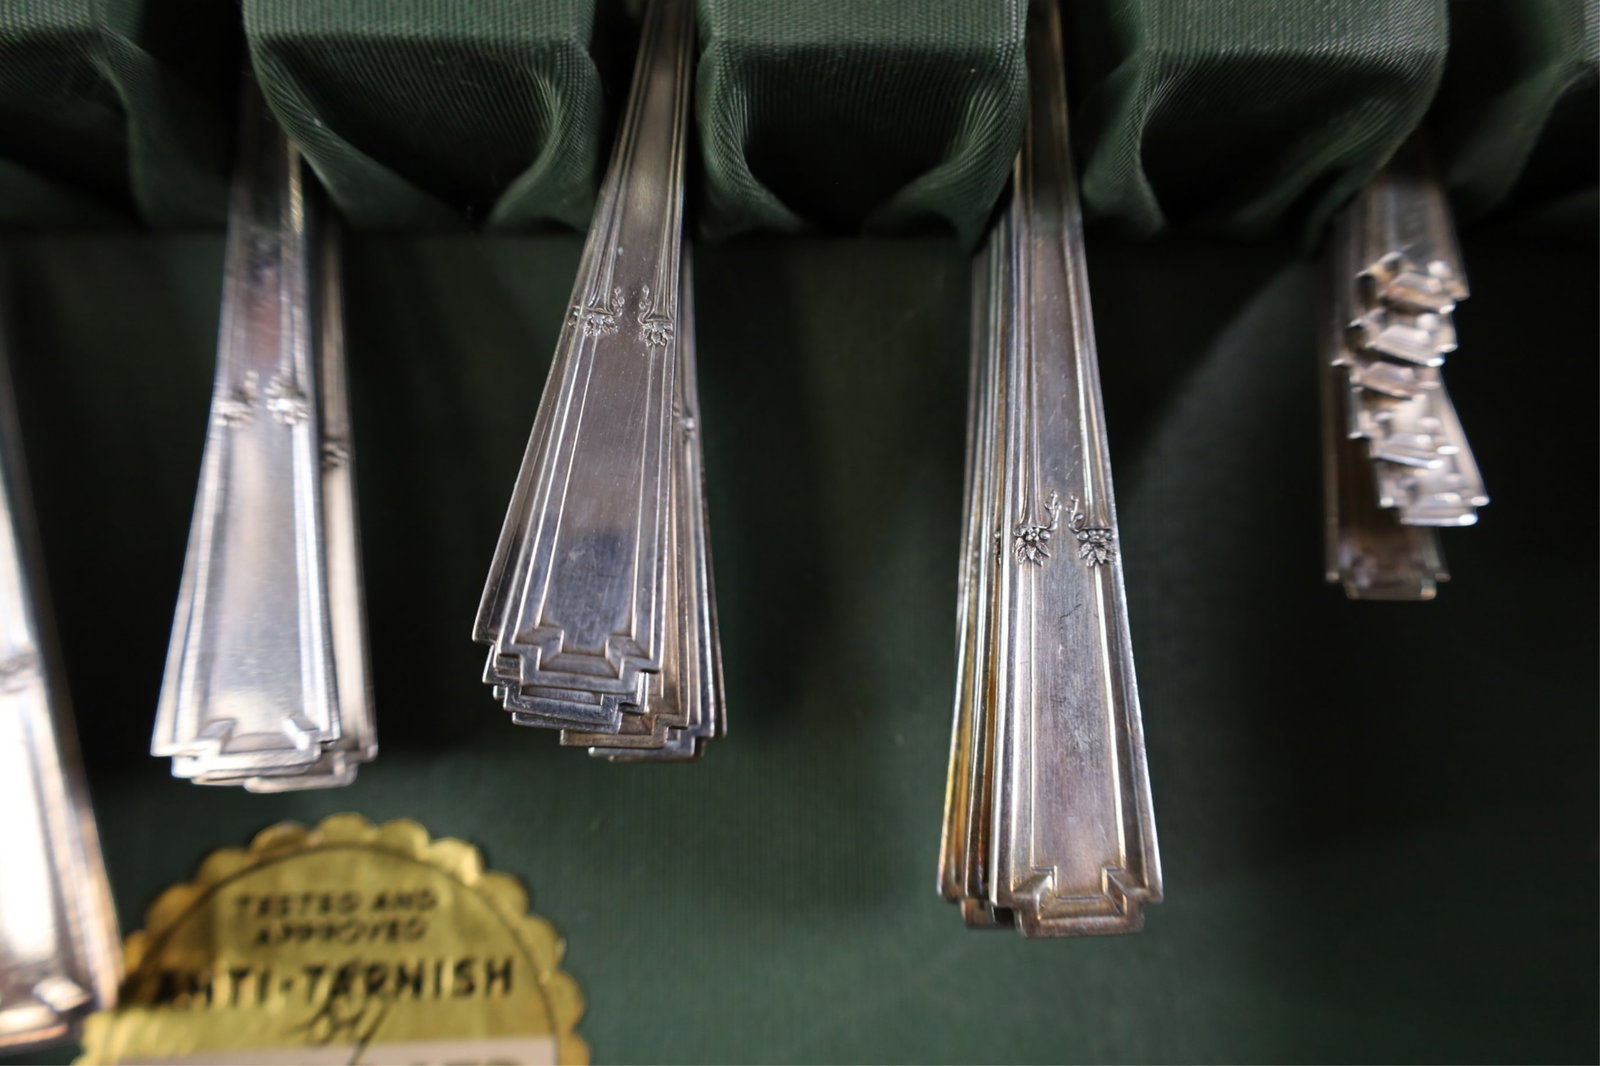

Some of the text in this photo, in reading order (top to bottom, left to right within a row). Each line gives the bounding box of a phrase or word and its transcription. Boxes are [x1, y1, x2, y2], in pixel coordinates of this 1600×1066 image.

[235, 889, 438, 917] TESTED AND
[256, 920, 428, 946] APPROVED
